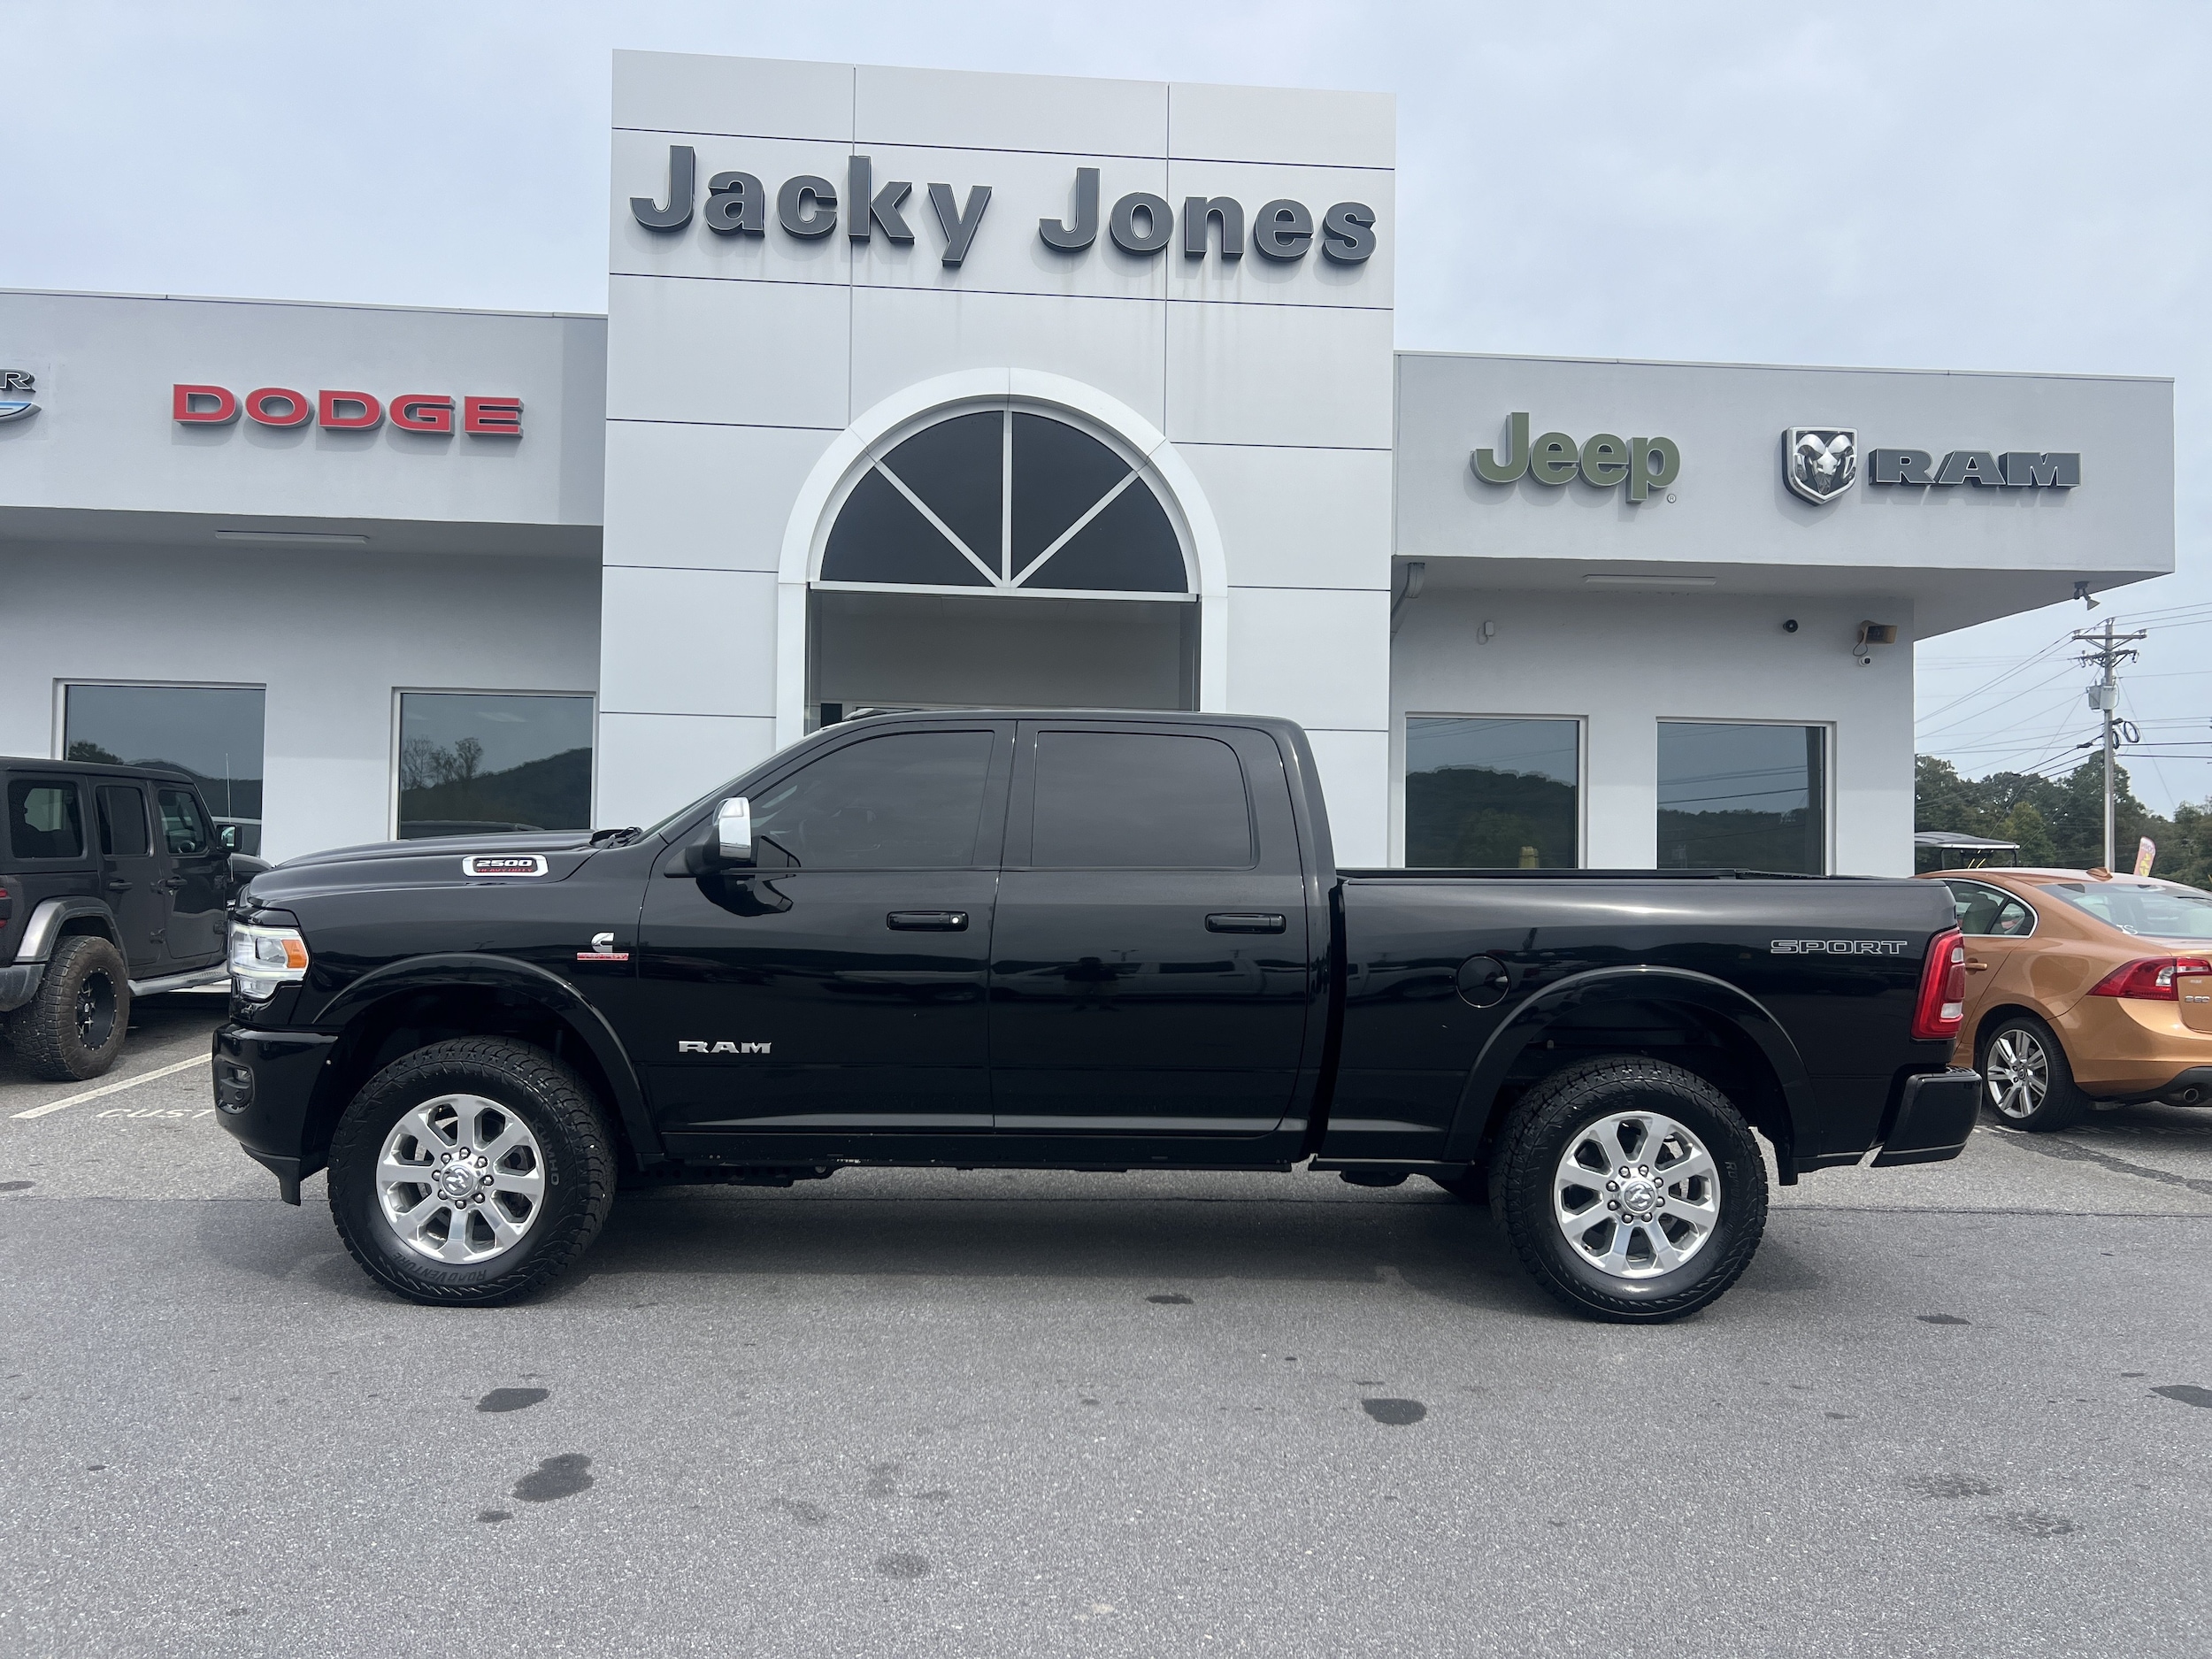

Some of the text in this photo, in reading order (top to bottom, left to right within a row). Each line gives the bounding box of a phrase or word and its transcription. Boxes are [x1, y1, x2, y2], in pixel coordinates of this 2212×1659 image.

[628, 144, 1378, 268] Jacky Jones
[172, 383, 525, 438] DODGE
[1470, 411, 1681, 503] Jeep
[1868, 448, 2082, 487] RAM
[1770, 939, 1909, 956] SPORT
[678, 1040, 772, 1055] RAM
